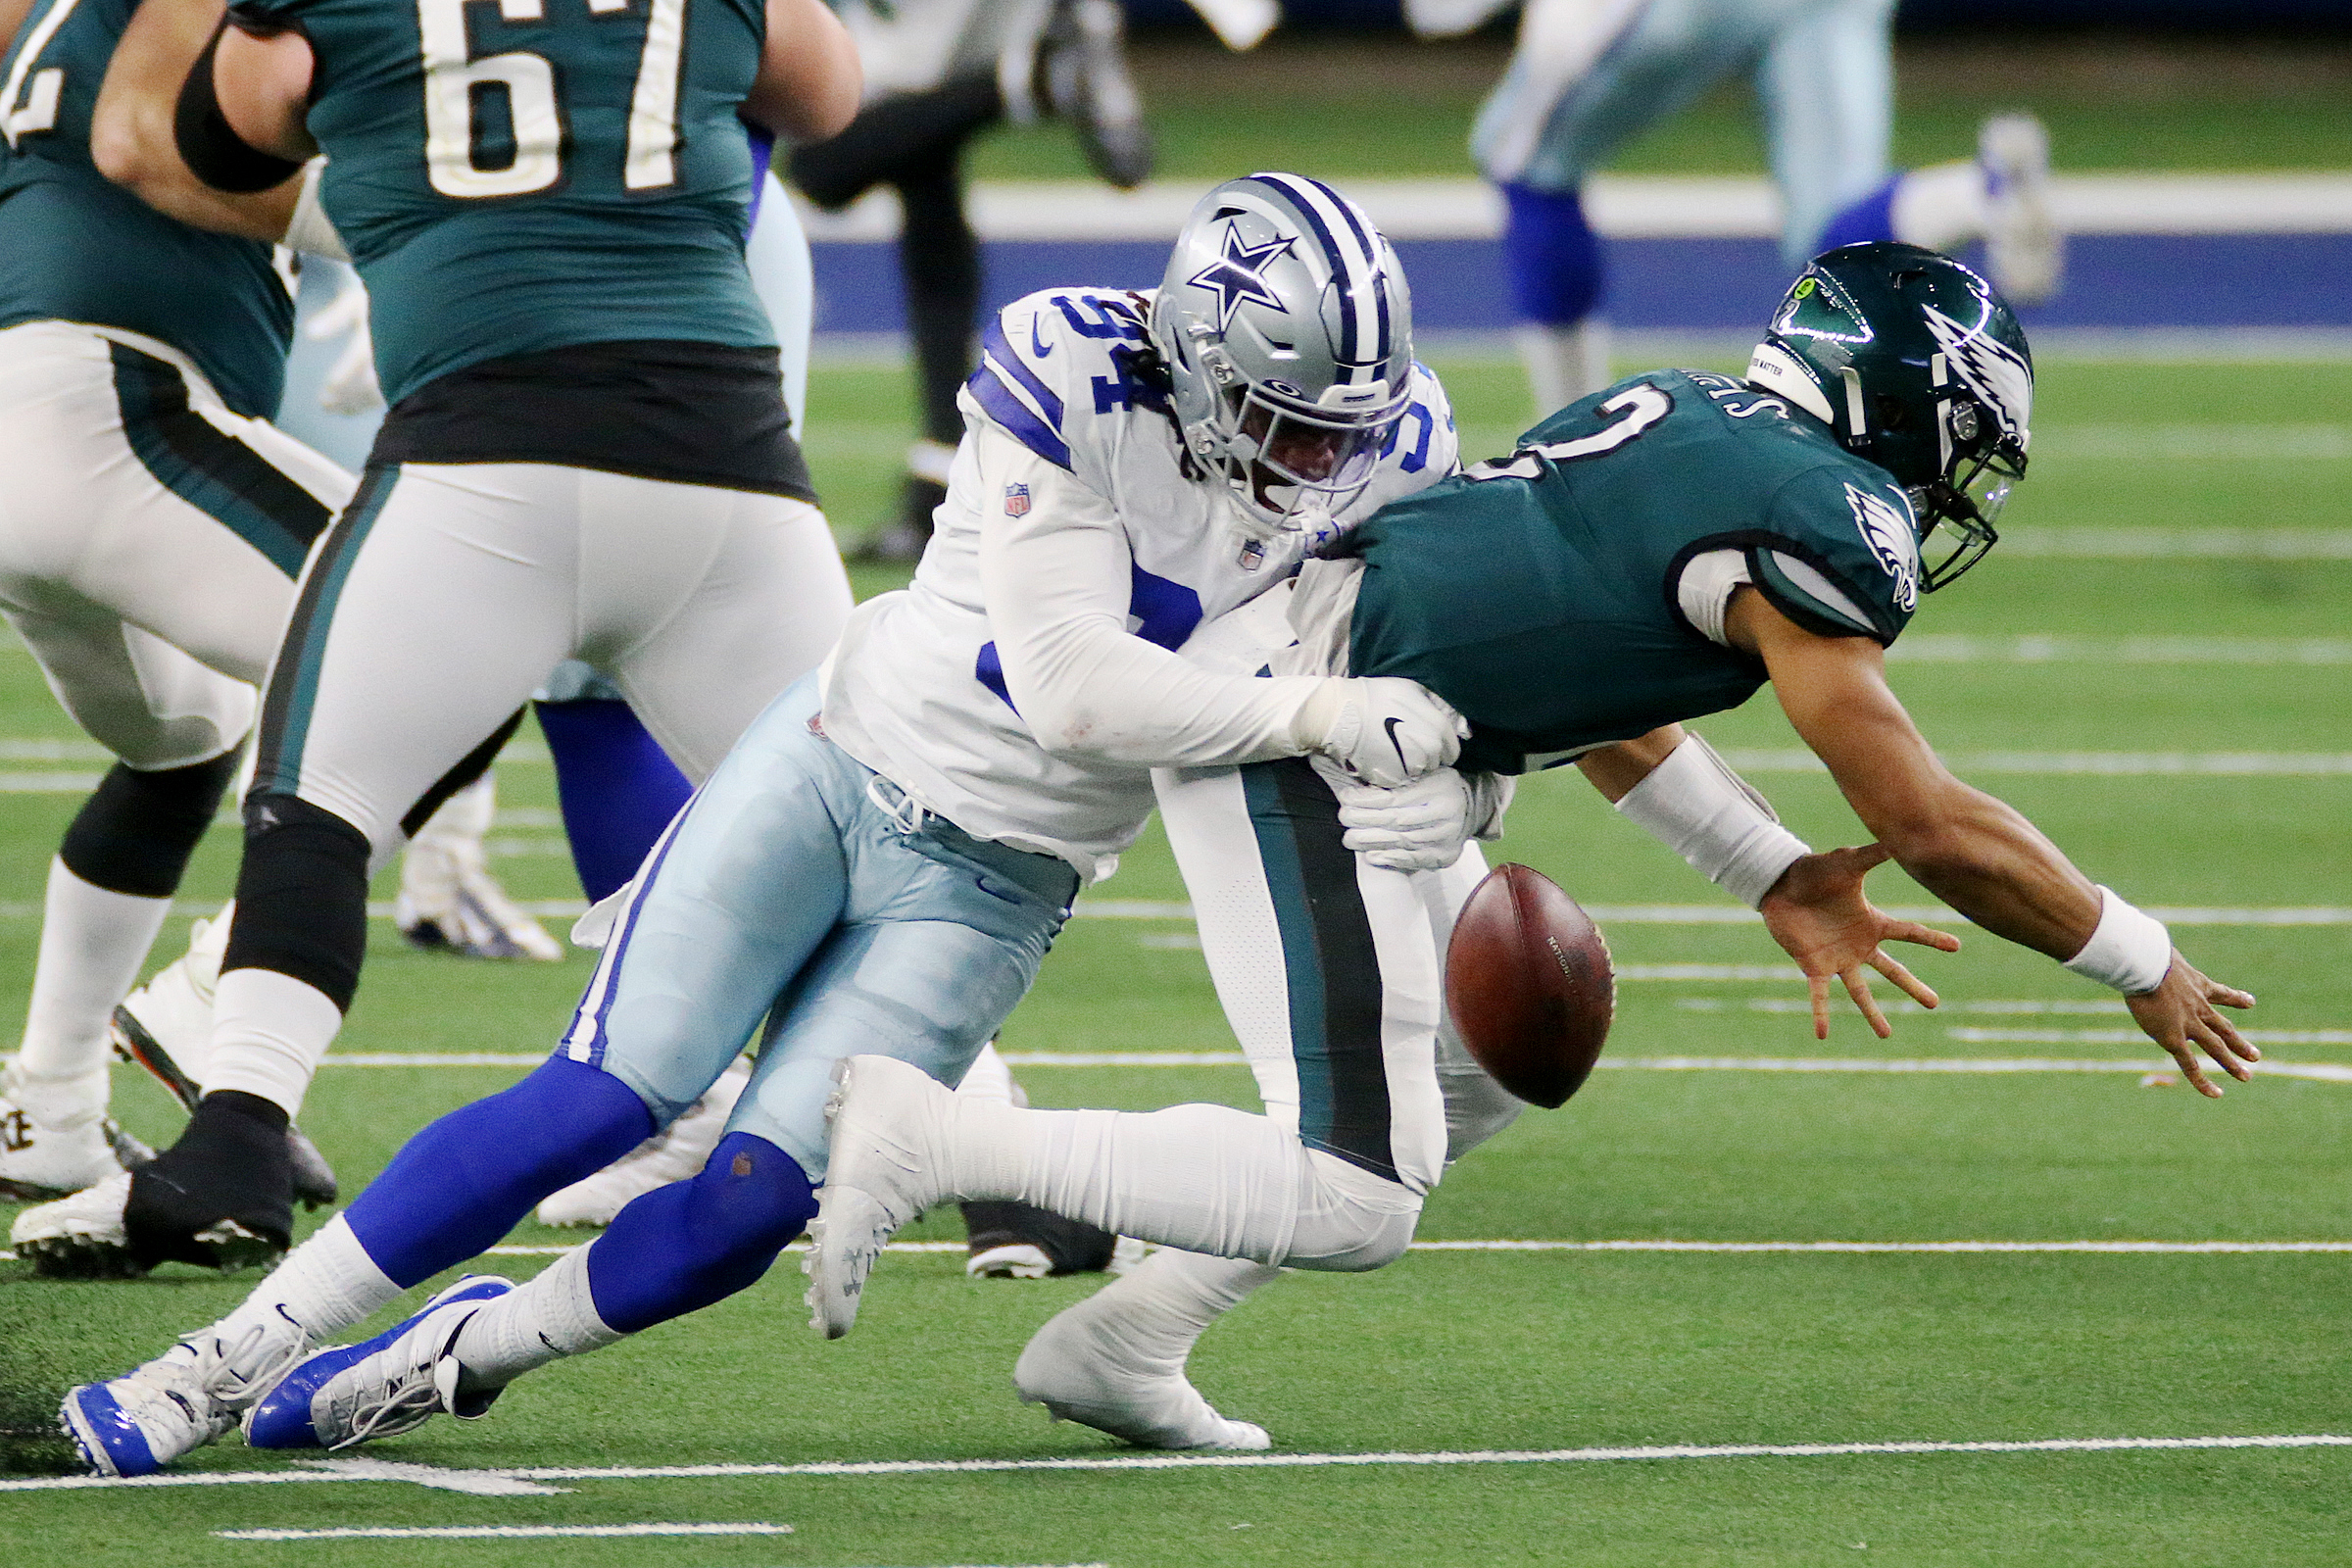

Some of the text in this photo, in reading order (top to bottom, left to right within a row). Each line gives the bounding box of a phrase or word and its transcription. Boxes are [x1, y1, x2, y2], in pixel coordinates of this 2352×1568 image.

[418, 0, 686, 199] 67
[1050, 294, 1172, 415] 94
[1759, 360, 1784, 377] MATTER
